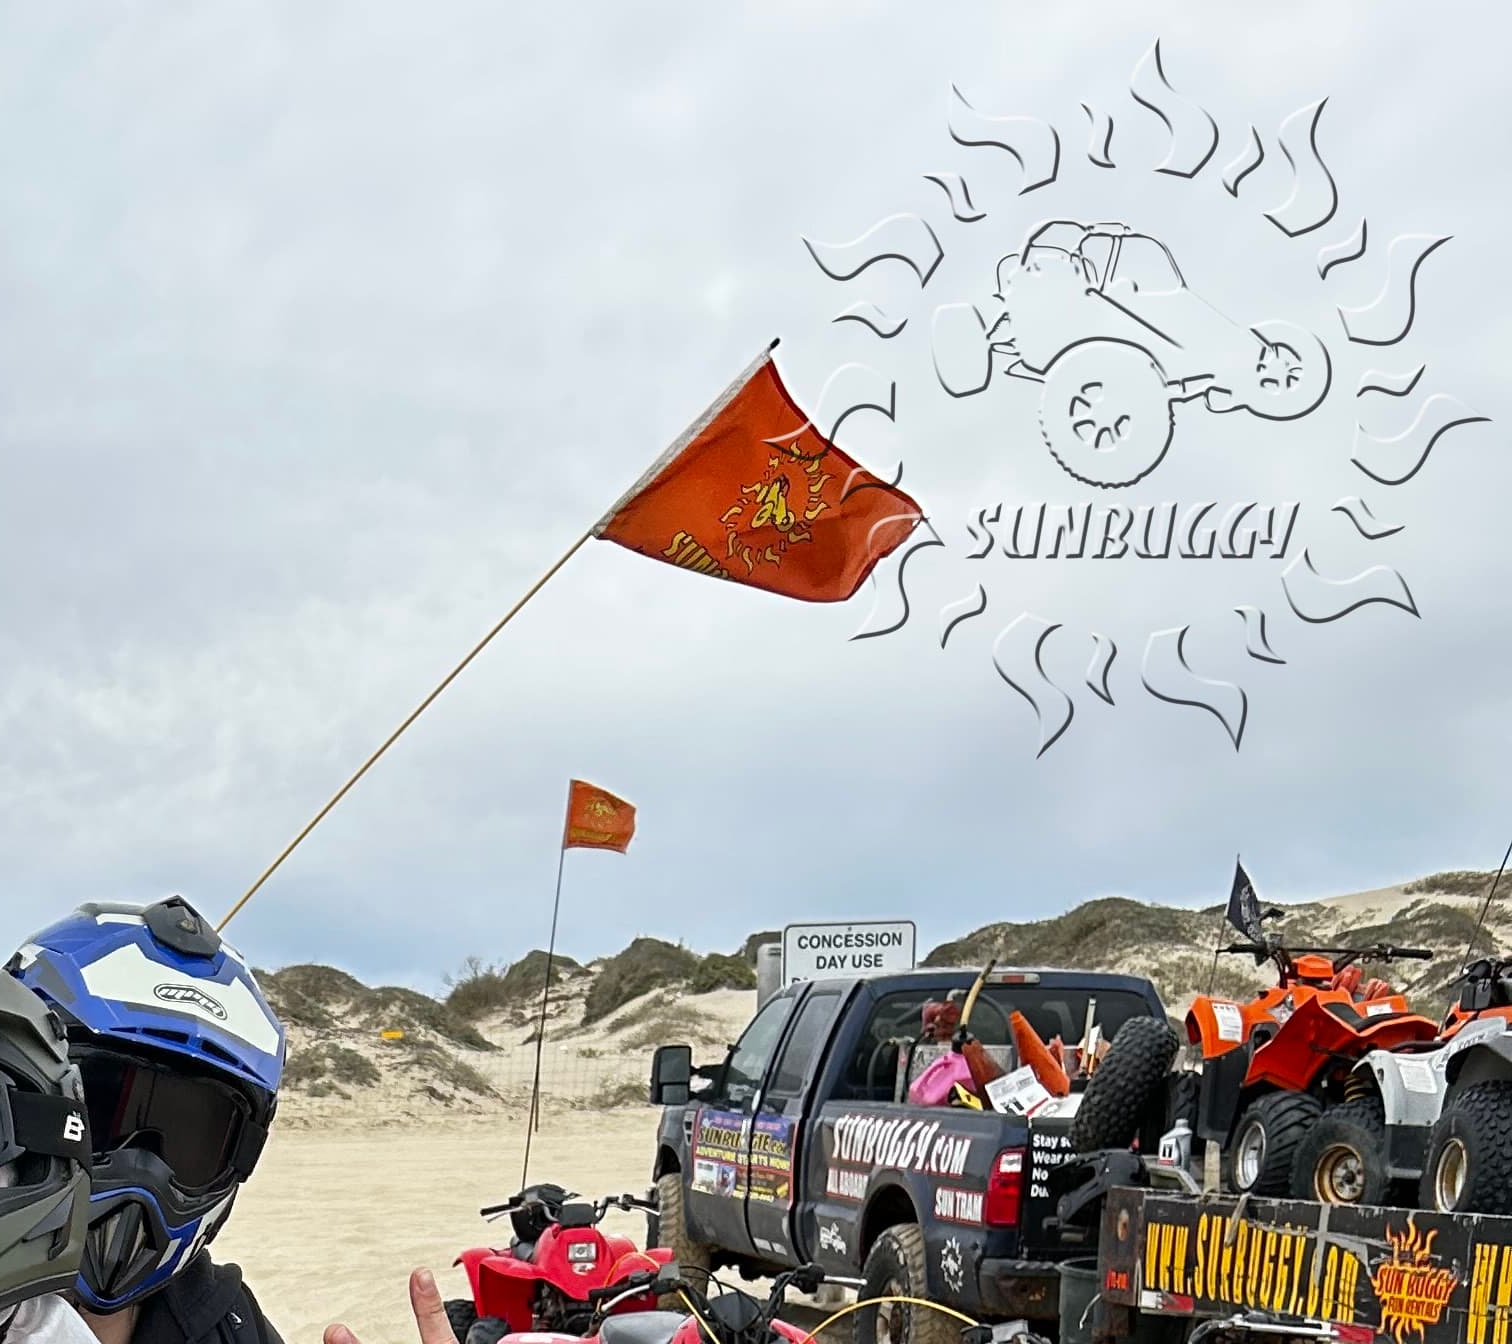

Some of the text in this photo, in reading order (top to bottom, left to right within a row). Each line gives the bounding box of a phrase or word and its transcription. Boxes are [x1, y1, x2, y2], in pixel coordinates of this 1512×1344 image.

[798, 932, 902, 949] CONCESSION
[816, 954, 883, 969] DAY USE
[1033, 1134, 1058, 1149] Stay
[737, 1153, 768, 1167] STRTS
[1032, 1151, 1062, 1164] Wear
[1032, 1168, 1049, 1181] No
[935, 1187, 984, 1223] SUN TRAM
[1375, 1267, 1456, 1303] SUN BUGGY
[1387, 1296, 1440, 1318] FUN RENTALS
